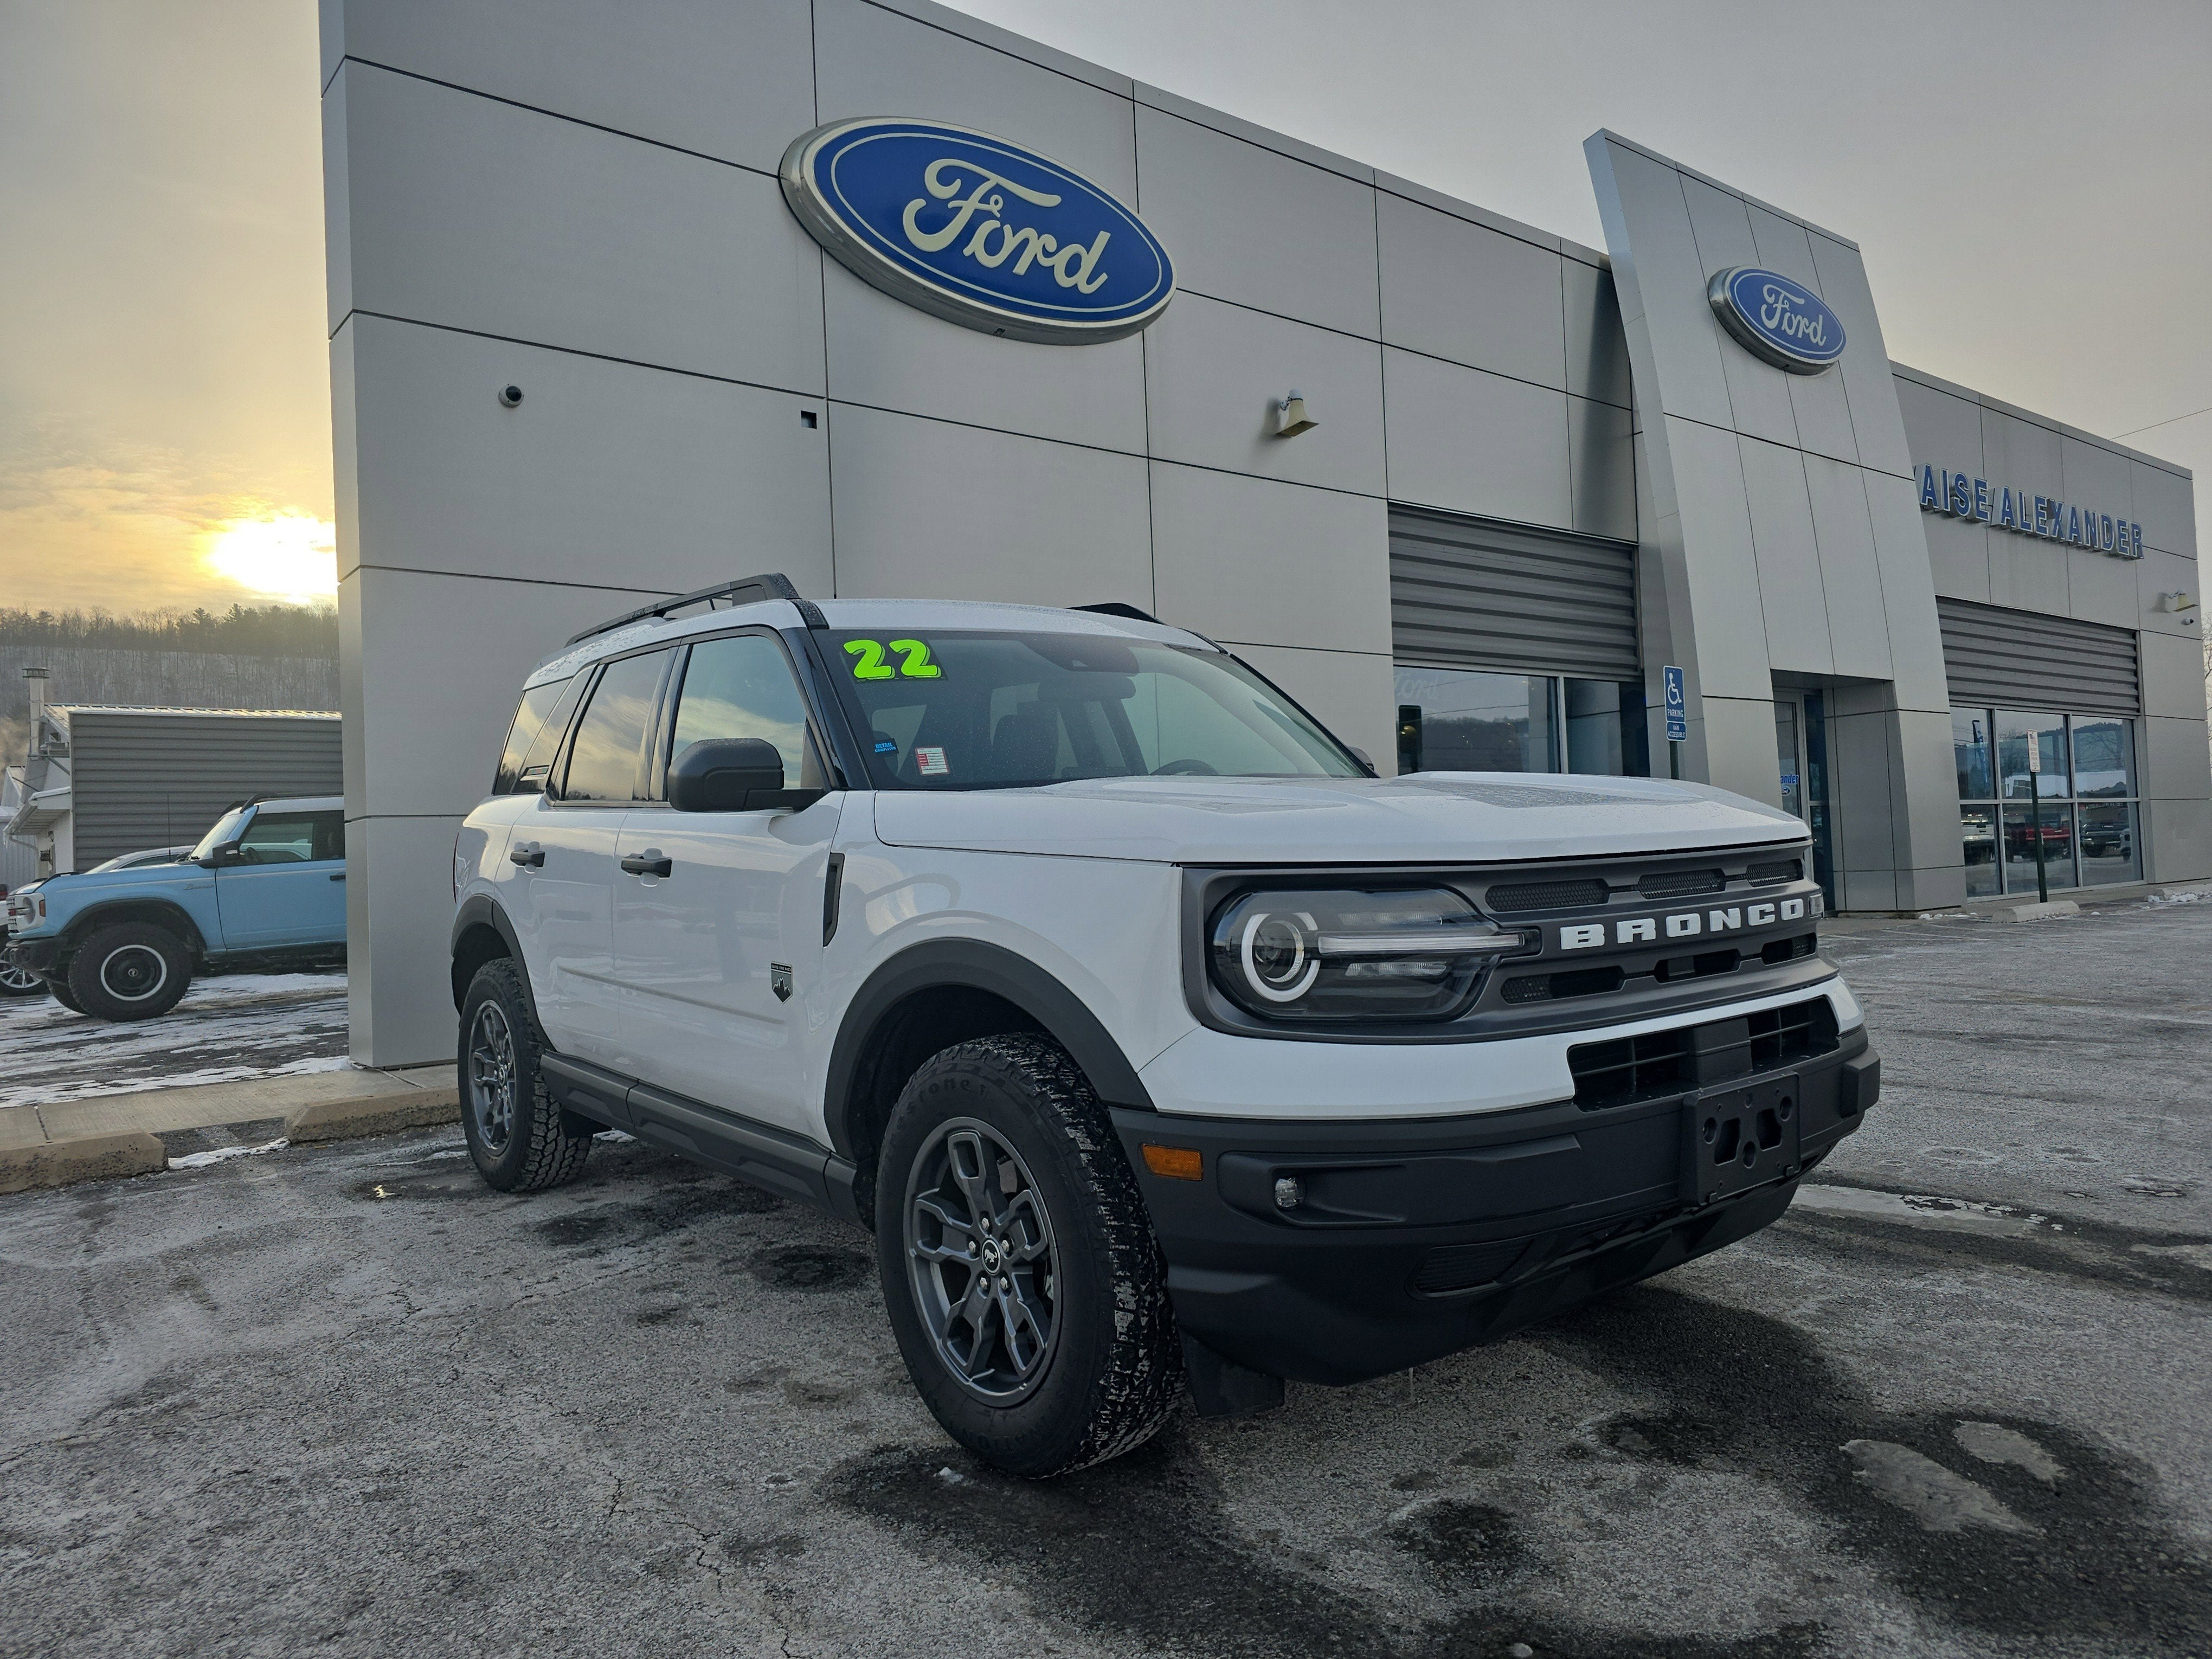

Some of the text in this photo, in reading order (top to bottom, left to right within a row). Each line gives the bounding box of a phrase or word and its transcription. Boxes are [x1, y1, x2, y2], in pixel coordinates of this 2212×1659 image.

[903, 158, 1112, 294] Ford
[1760, 284, 1827, 346] Ford
[1918, 463, 2144, 559] AISE ALEXANDER
[843, 639, 941, 679] 22
[1667, 709, 1684, 718] PARKING
[1560, 898, 1804, 950] BRONCO
